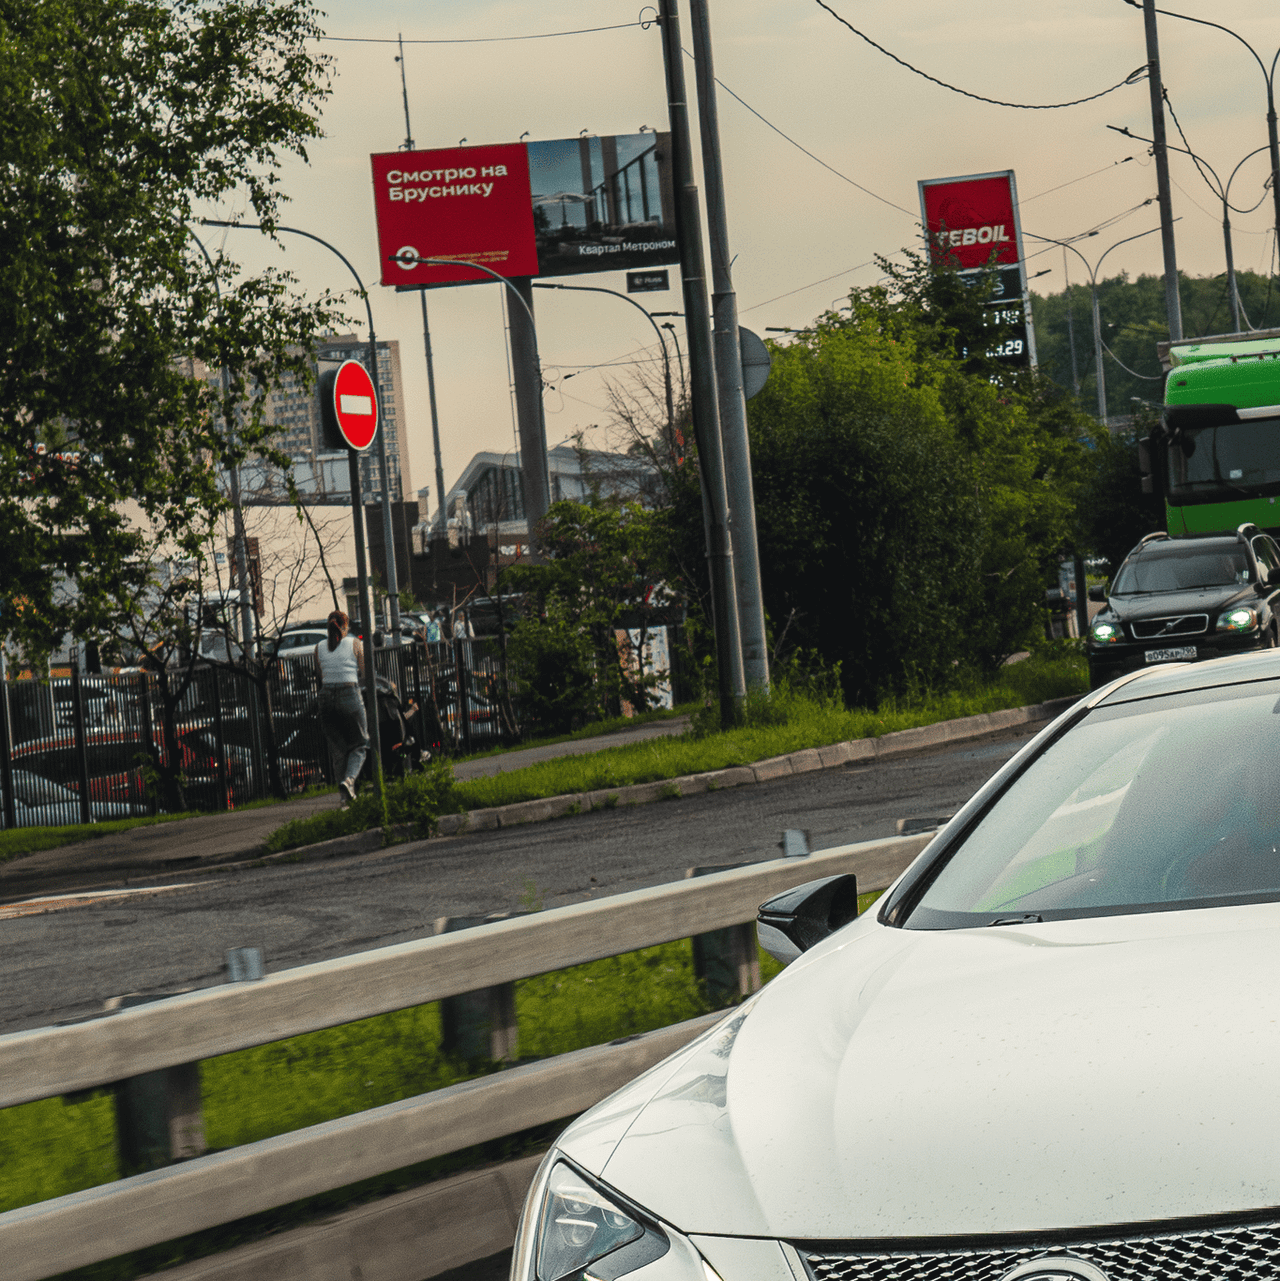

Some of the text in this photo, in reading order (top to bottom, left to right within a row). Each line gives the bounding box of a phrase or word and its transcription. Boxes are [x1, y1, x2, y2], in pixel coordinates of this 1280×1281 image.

[387, 164, 508, 184] Смотрю на
[389, 182, 494, 203] Бруснику
[579, 240, 676, 256] Квартал Метроном
